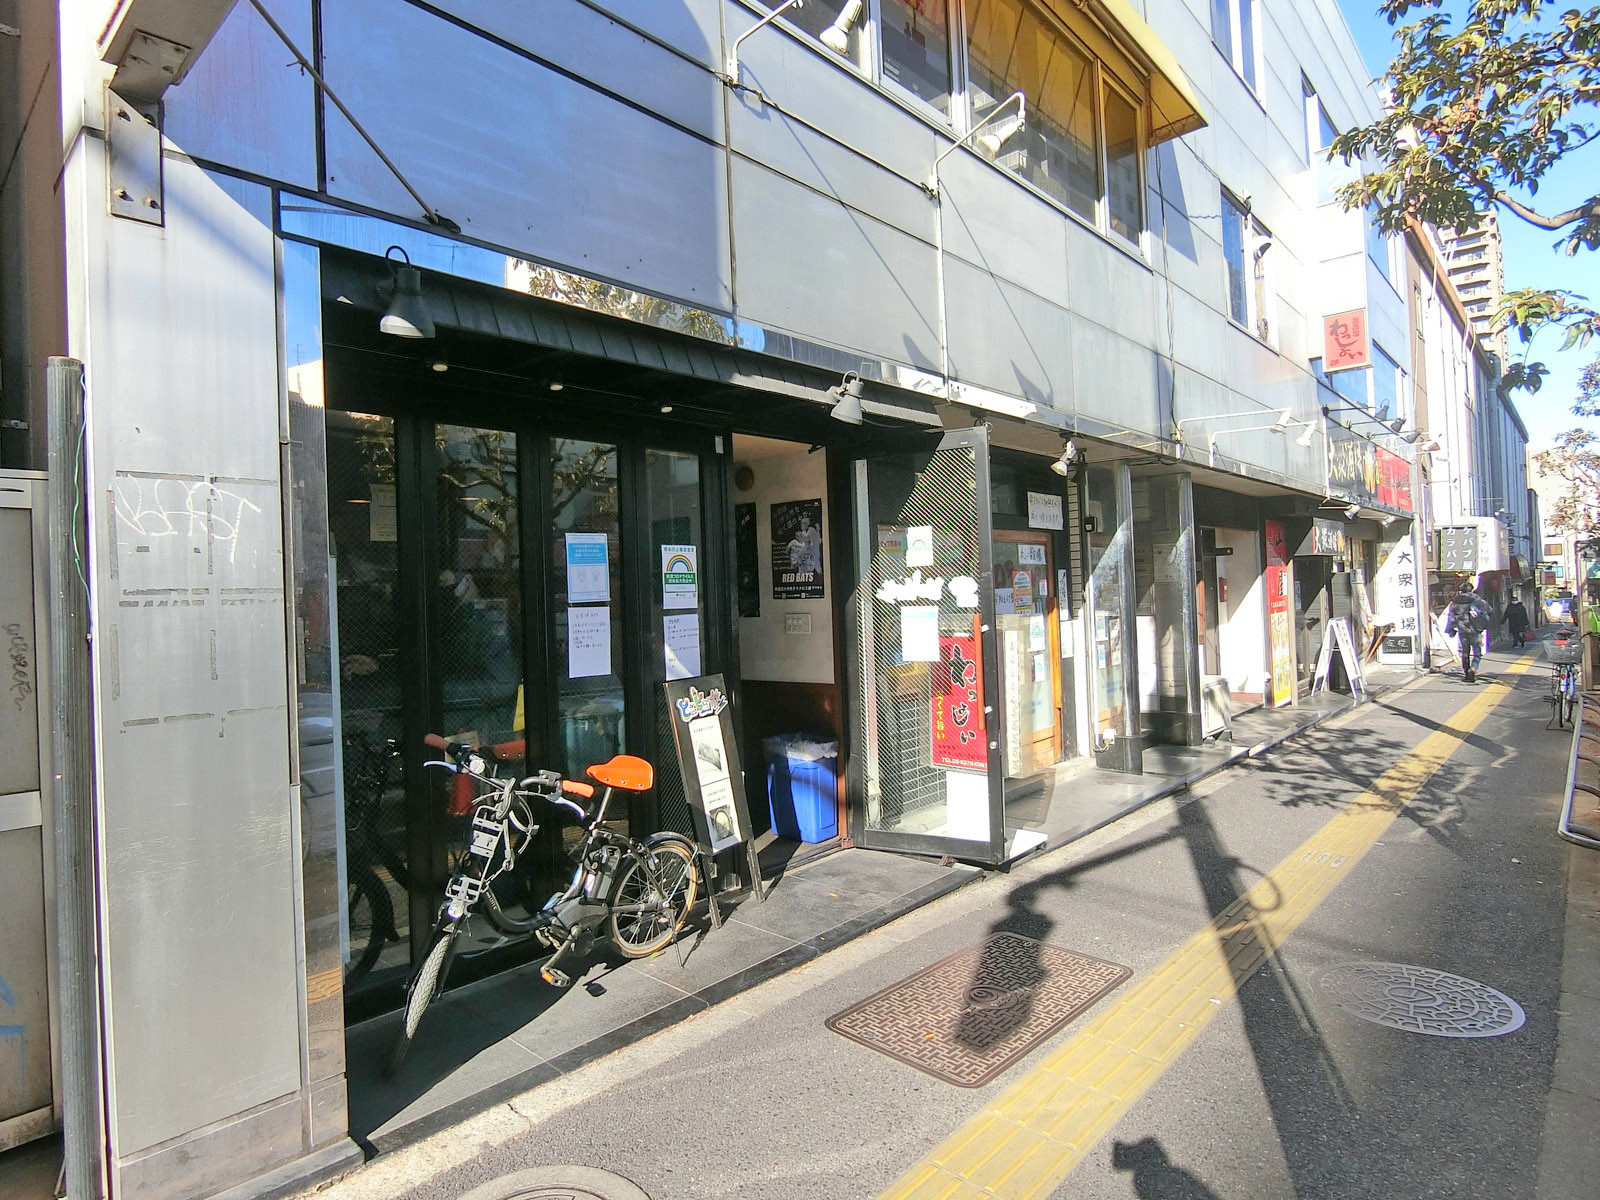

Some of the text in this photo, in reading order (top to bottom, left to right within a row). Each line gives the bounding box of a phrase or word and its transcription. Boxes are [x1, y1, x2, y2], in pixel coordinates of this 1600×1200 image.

[1446, 527, 1457, 570] カラバフ
[1462, 526, 1474, 570] ケバブ屋
[782, 572, 814, 583] RED BATS
[1397, 551, 1416, 631] 大衆酒場
